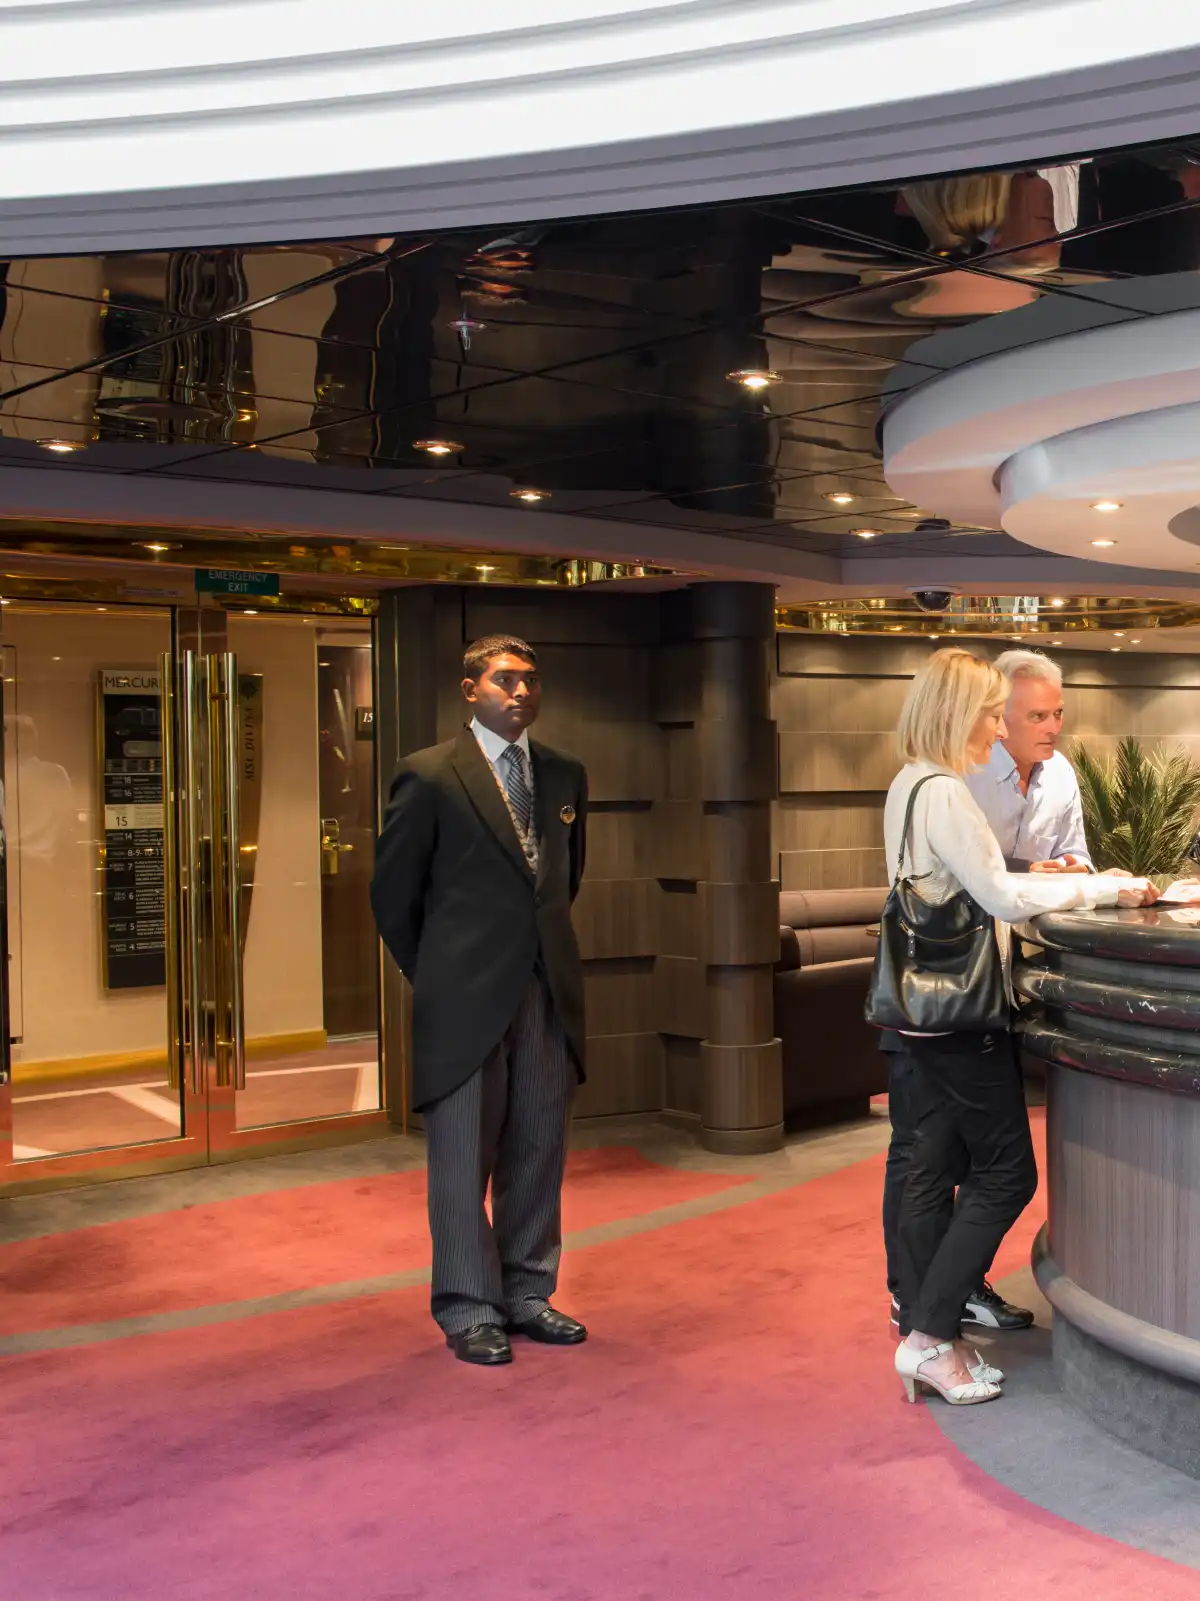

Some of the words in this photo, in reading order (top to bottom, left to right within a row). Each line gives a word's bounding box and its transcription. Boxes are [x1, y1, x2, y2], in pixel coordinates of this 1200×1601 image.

[208, 569, 268, 582] EMERGENCY
[228, 582, 249, 592] EXIT
[104, 676, 161, 688] MERCUR
[115, 816, 128, 827] 15
[128, 892, 134, 900] 6
